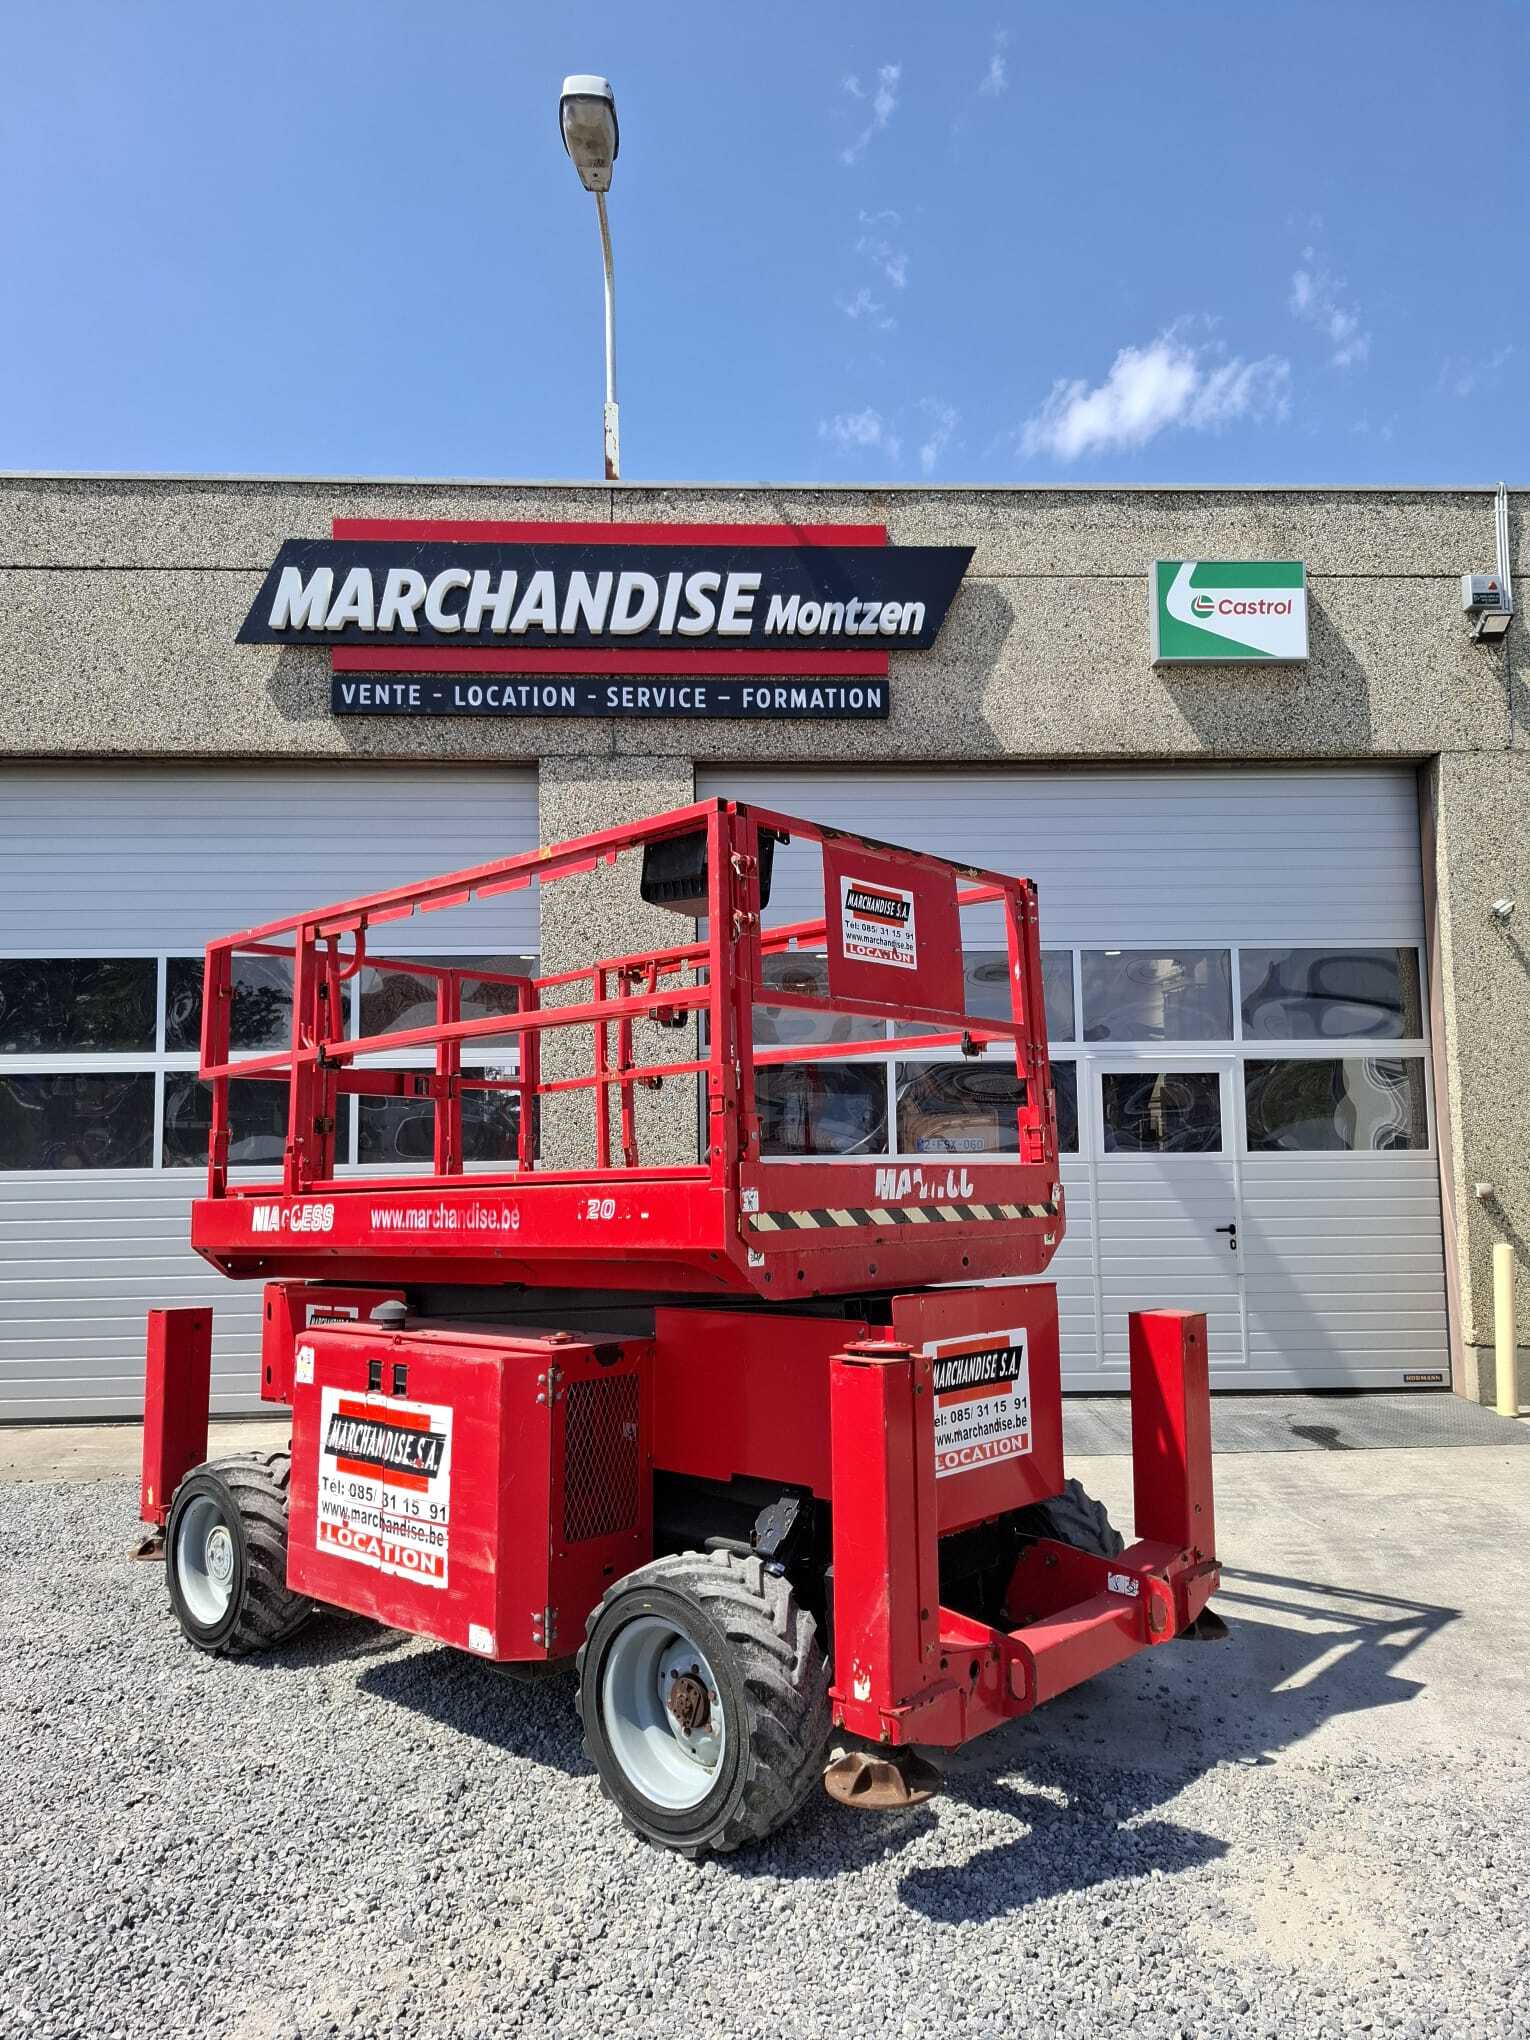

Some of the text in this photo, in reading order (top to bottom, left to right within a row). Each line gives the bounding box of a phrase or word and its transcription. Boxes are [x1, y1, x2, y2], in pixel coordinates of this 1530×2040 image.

[268, 566, 926, 636] MARCHANDISE Montzen
[1218, 599, 1292, 615] Castrol
[341, 683, 421, 705] VENTE
[454, 685, 575, 707] LOCATION
[606, 686, 706, 708] SERVICE
[742, 688, 881, 709] FORMATION
[847, 893, 895, 917] MARCHANDISE
[880, 927, 889, 936] 31
[892, 929, 901, 938] 15
[905, 932, 914, 941] 91
[370, 1201, 520, 1230] www.marchandise.be
[933, 1351, 1019, 1389] MARCHANDISE S.A.
[935, 1396, 1027, 1427] él: 085/ 31 15 91
[328, 1419, 416, 1464] MARCHANDISE
[935, 1413, 1028, 1447] ww.marchandise.be
[936, 1435, 1022, 1470] LOCATION
[322, 1476, 447, 1522] Tél: 085/ 31 15 91
[322, 1500, 444, 1547] www.marchandise.be
[326, 1524, 436, 1573] LOCATION
